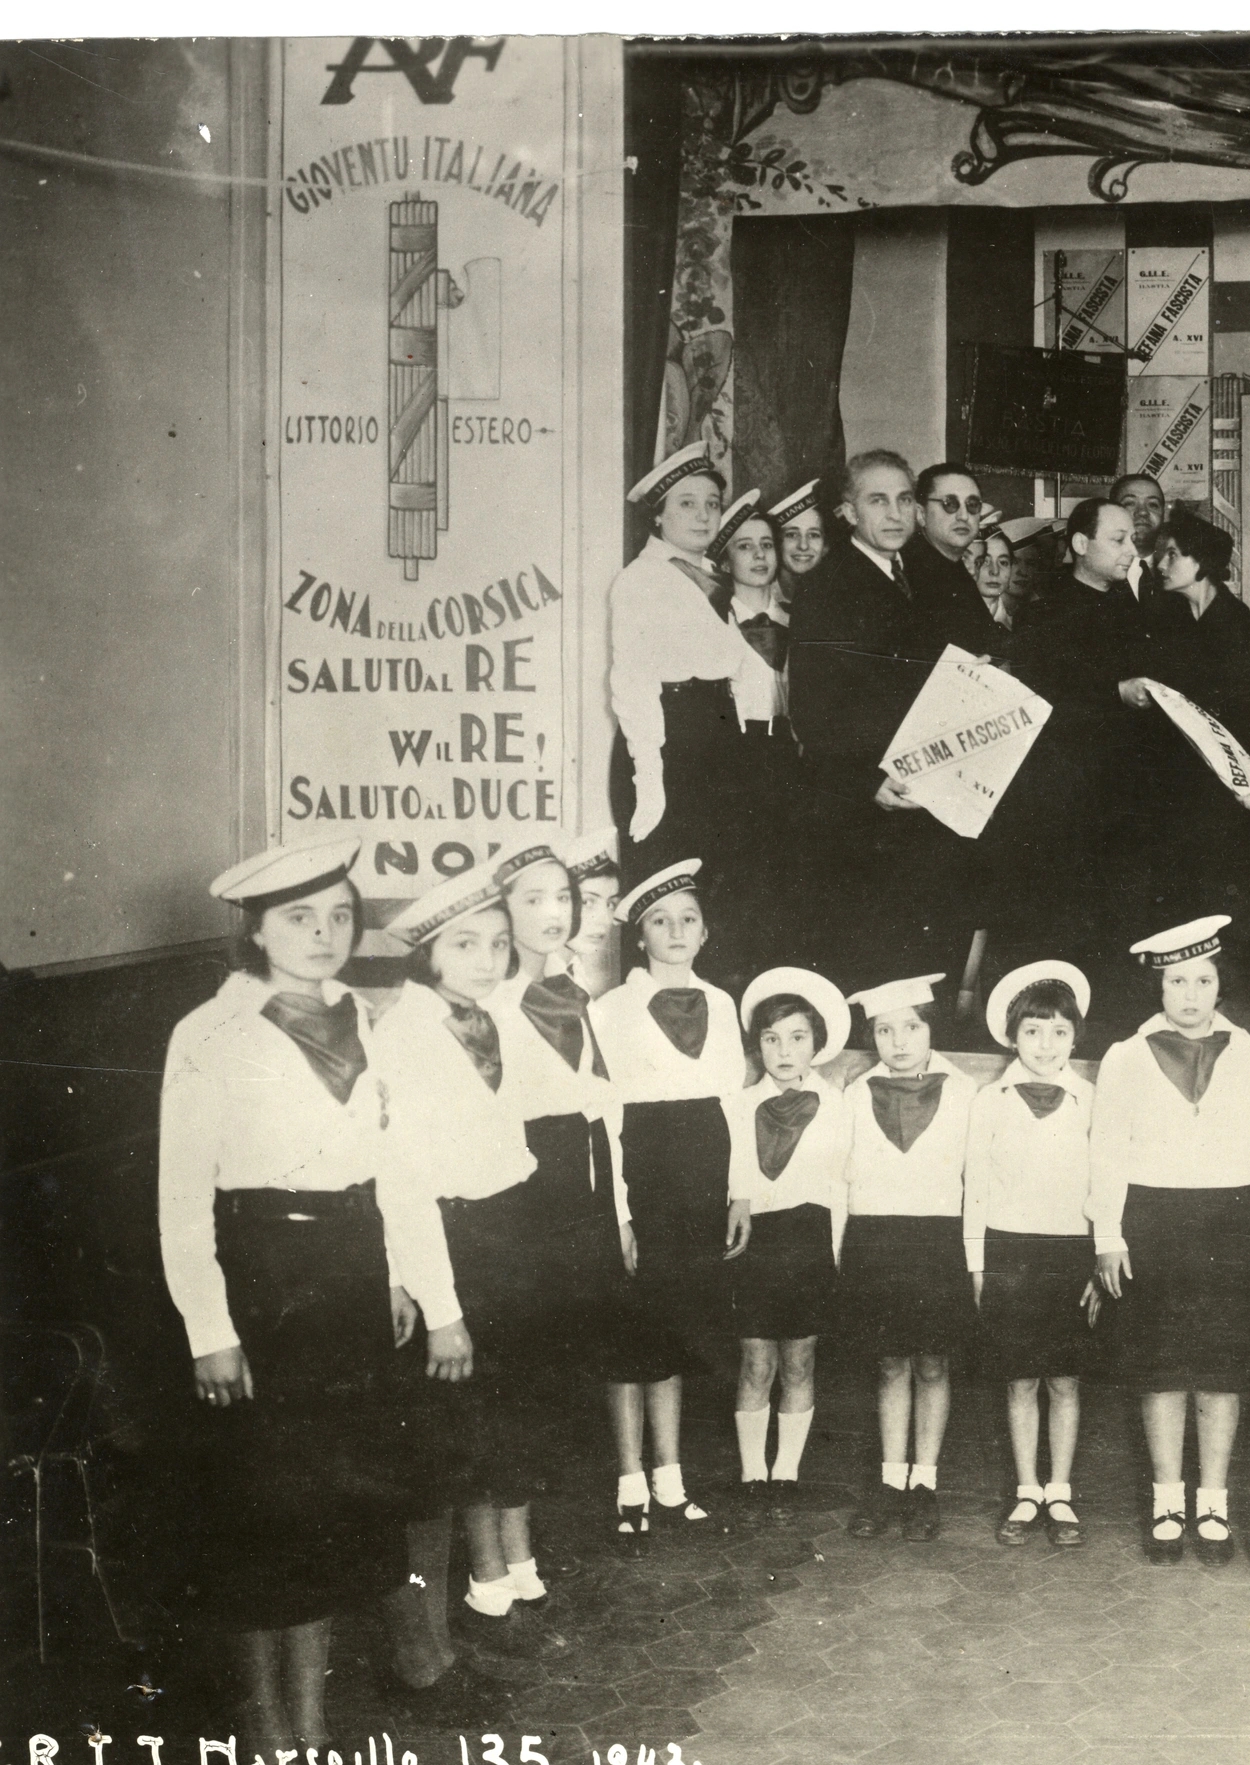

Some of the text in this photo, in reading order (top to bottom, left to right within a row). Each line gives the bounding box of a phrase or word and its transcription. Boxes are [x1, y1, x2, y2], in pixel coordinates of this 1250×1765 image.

[286, 136, 559, 228] GIOVENTU ITALIANA
[1161, 273, 1203, 324] FASCISTA
[285, 416, 532, 445] LITTORIO ESTERO
[1161, 402, 1203, 453] FASCISTA
[285, 563, 562, 642] ZONA DELLA CORSICA
[288, 636, 536, 693] SALUTO AL RE
[436, 742, 454, 763] IL
[892, 706, 1033, 779] BEFANA FASCISTA
[287, 775, 558, 822] SALUTO AL DUCE
[374, 841, 502, 878] NO
